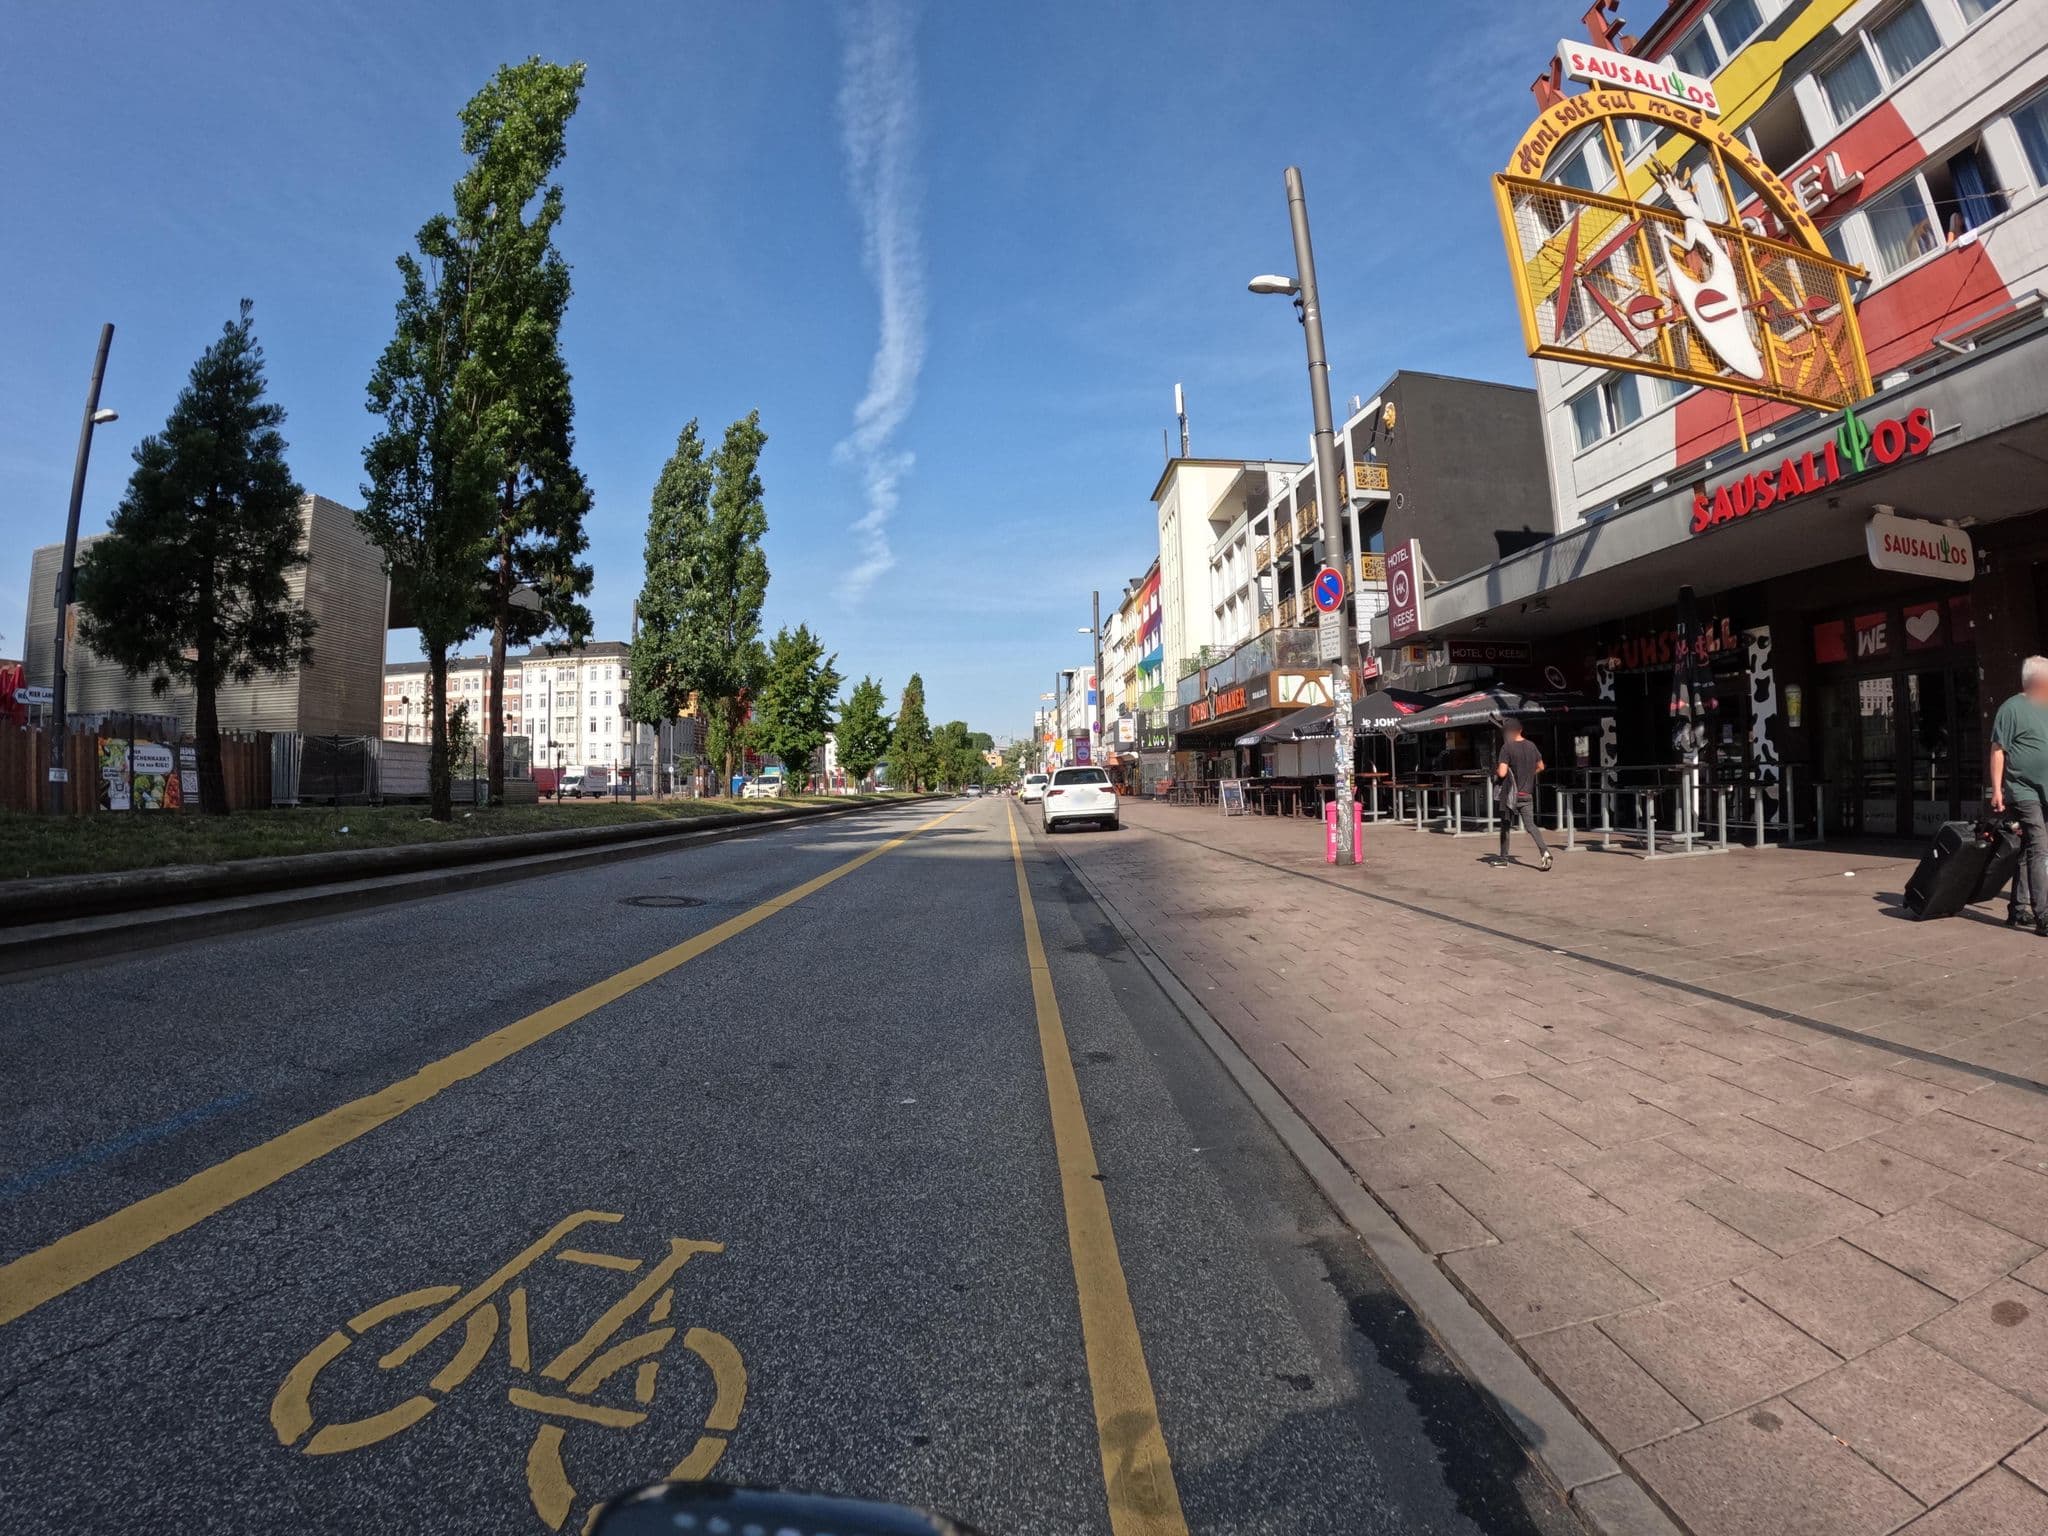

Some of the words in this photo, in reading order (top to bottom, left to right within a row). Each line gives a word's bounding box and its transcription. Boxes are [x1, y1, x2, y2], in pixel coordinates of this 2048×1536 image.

[1387, 548, 1409, 568] HOTEL
[1393, 608, 1415, 628] KEESE
[1858, 622, 1887, 657] WE
